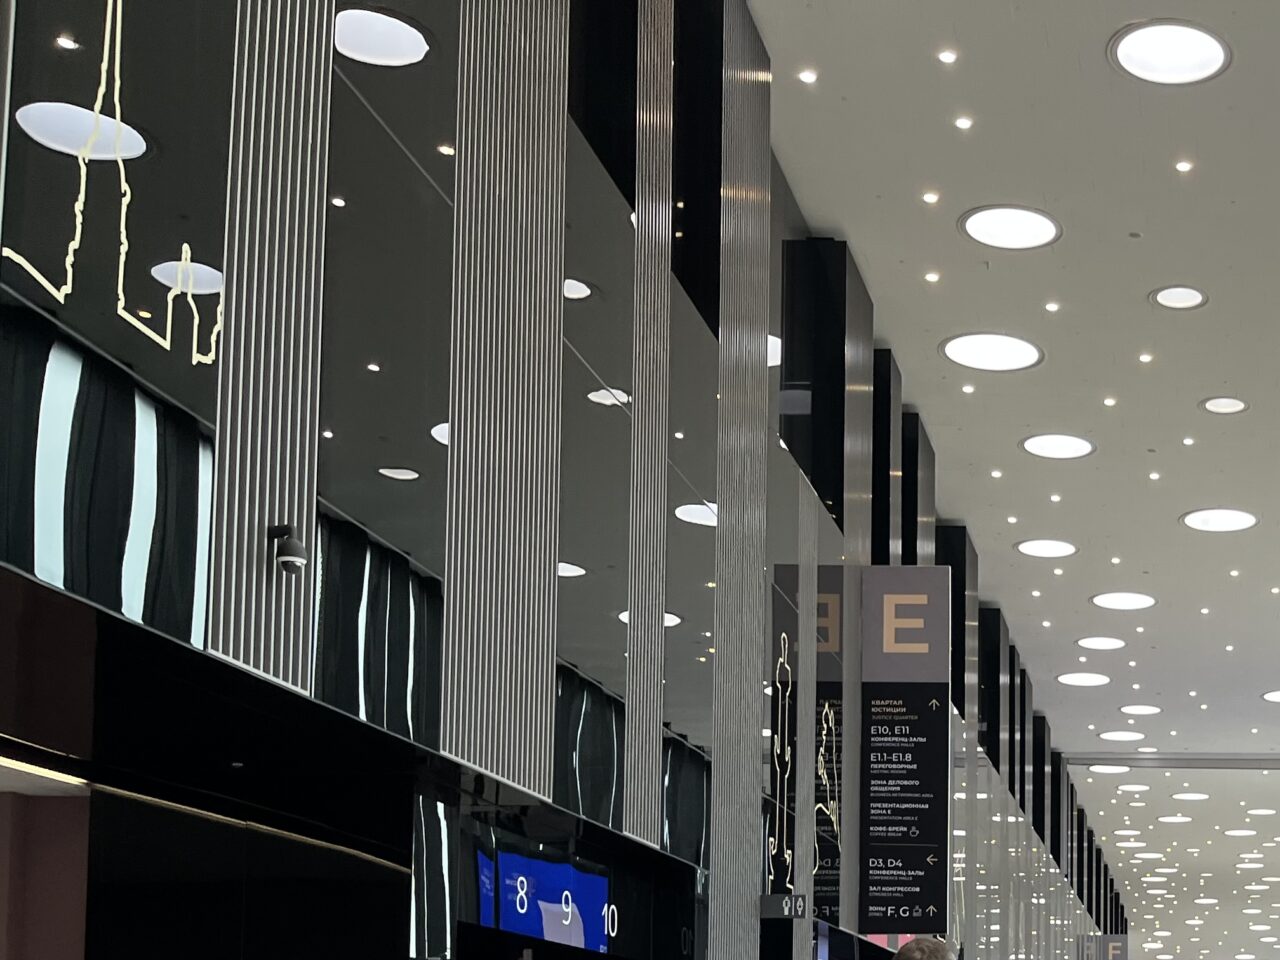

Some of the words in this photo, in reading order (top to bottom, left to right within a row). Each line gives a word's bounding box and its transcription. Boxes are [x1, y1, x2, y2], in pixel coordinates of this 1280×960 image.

[883, 594, 929, 653] E
[871, 706, 907, 714] ЮСТИЦИИ
[870, 725, 891, 736] E10,
[894, 725, 910, 735] E11
[869, 858, 885, 868] D3,
[887, 858, 903, 868] D4
[516, 876, 528, 914] 8
[561, 890, 572, 925] 9
[601, 903, 618, 937] 10
[887, 906, 898, 918] F,
[899, 906, 910, 917] G
[1108, 942, 1122, 960] F
